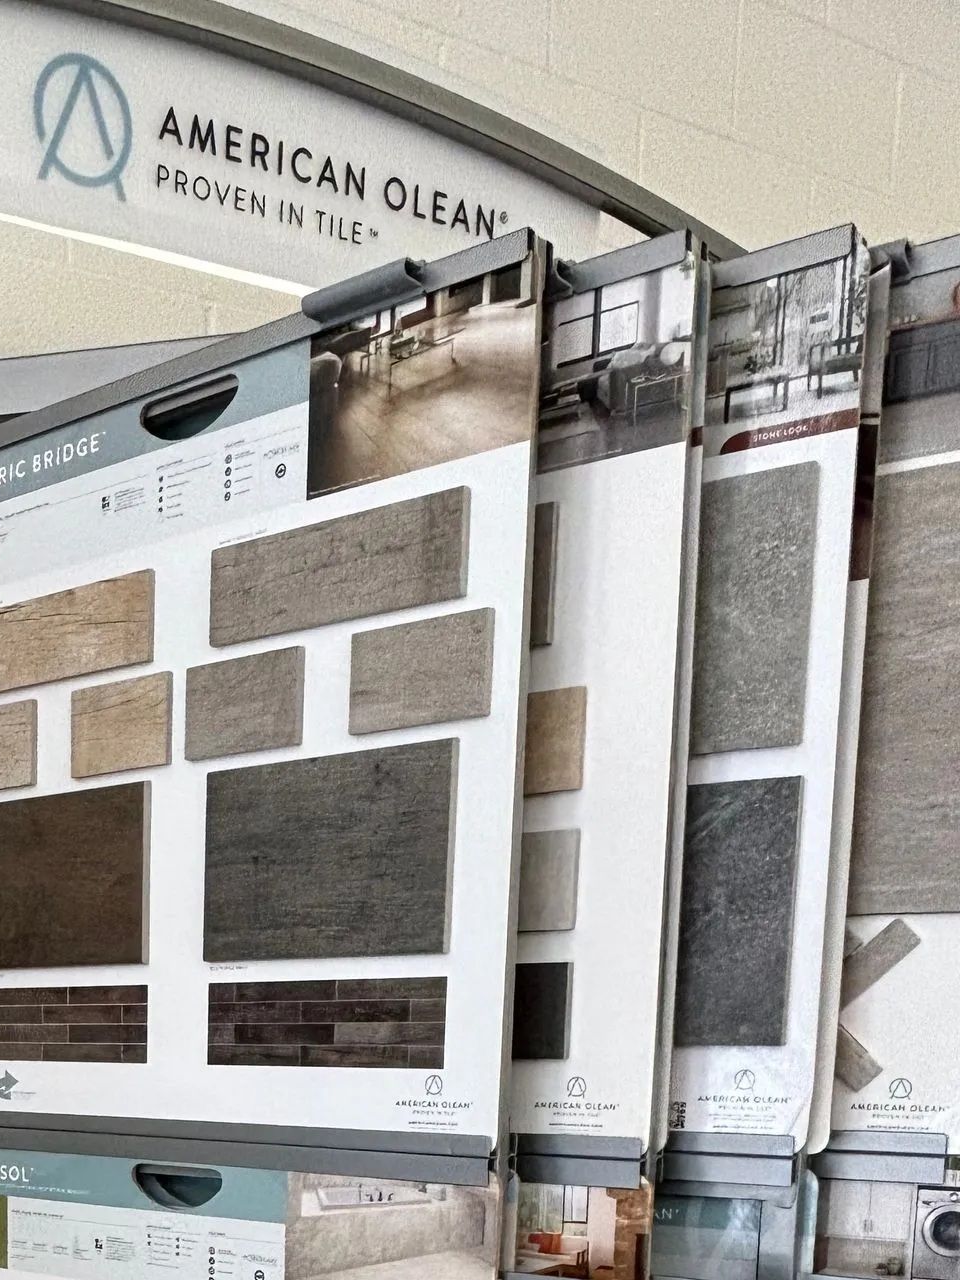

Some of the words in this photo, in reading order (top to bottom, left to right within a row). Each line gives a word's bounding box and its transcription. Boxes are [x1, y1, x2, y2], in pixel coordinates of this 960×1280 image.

[158, 106, 367, 202] AMERICAN
[155, 163, 267, 218] PROVEN
[278, 198, 306, 230] IN
[32, 432, 102, 474] BRIDGE
[697, 1095, 750, 1104] AMERICAN
[850, 1103, 906, 1112] AMERICAN
